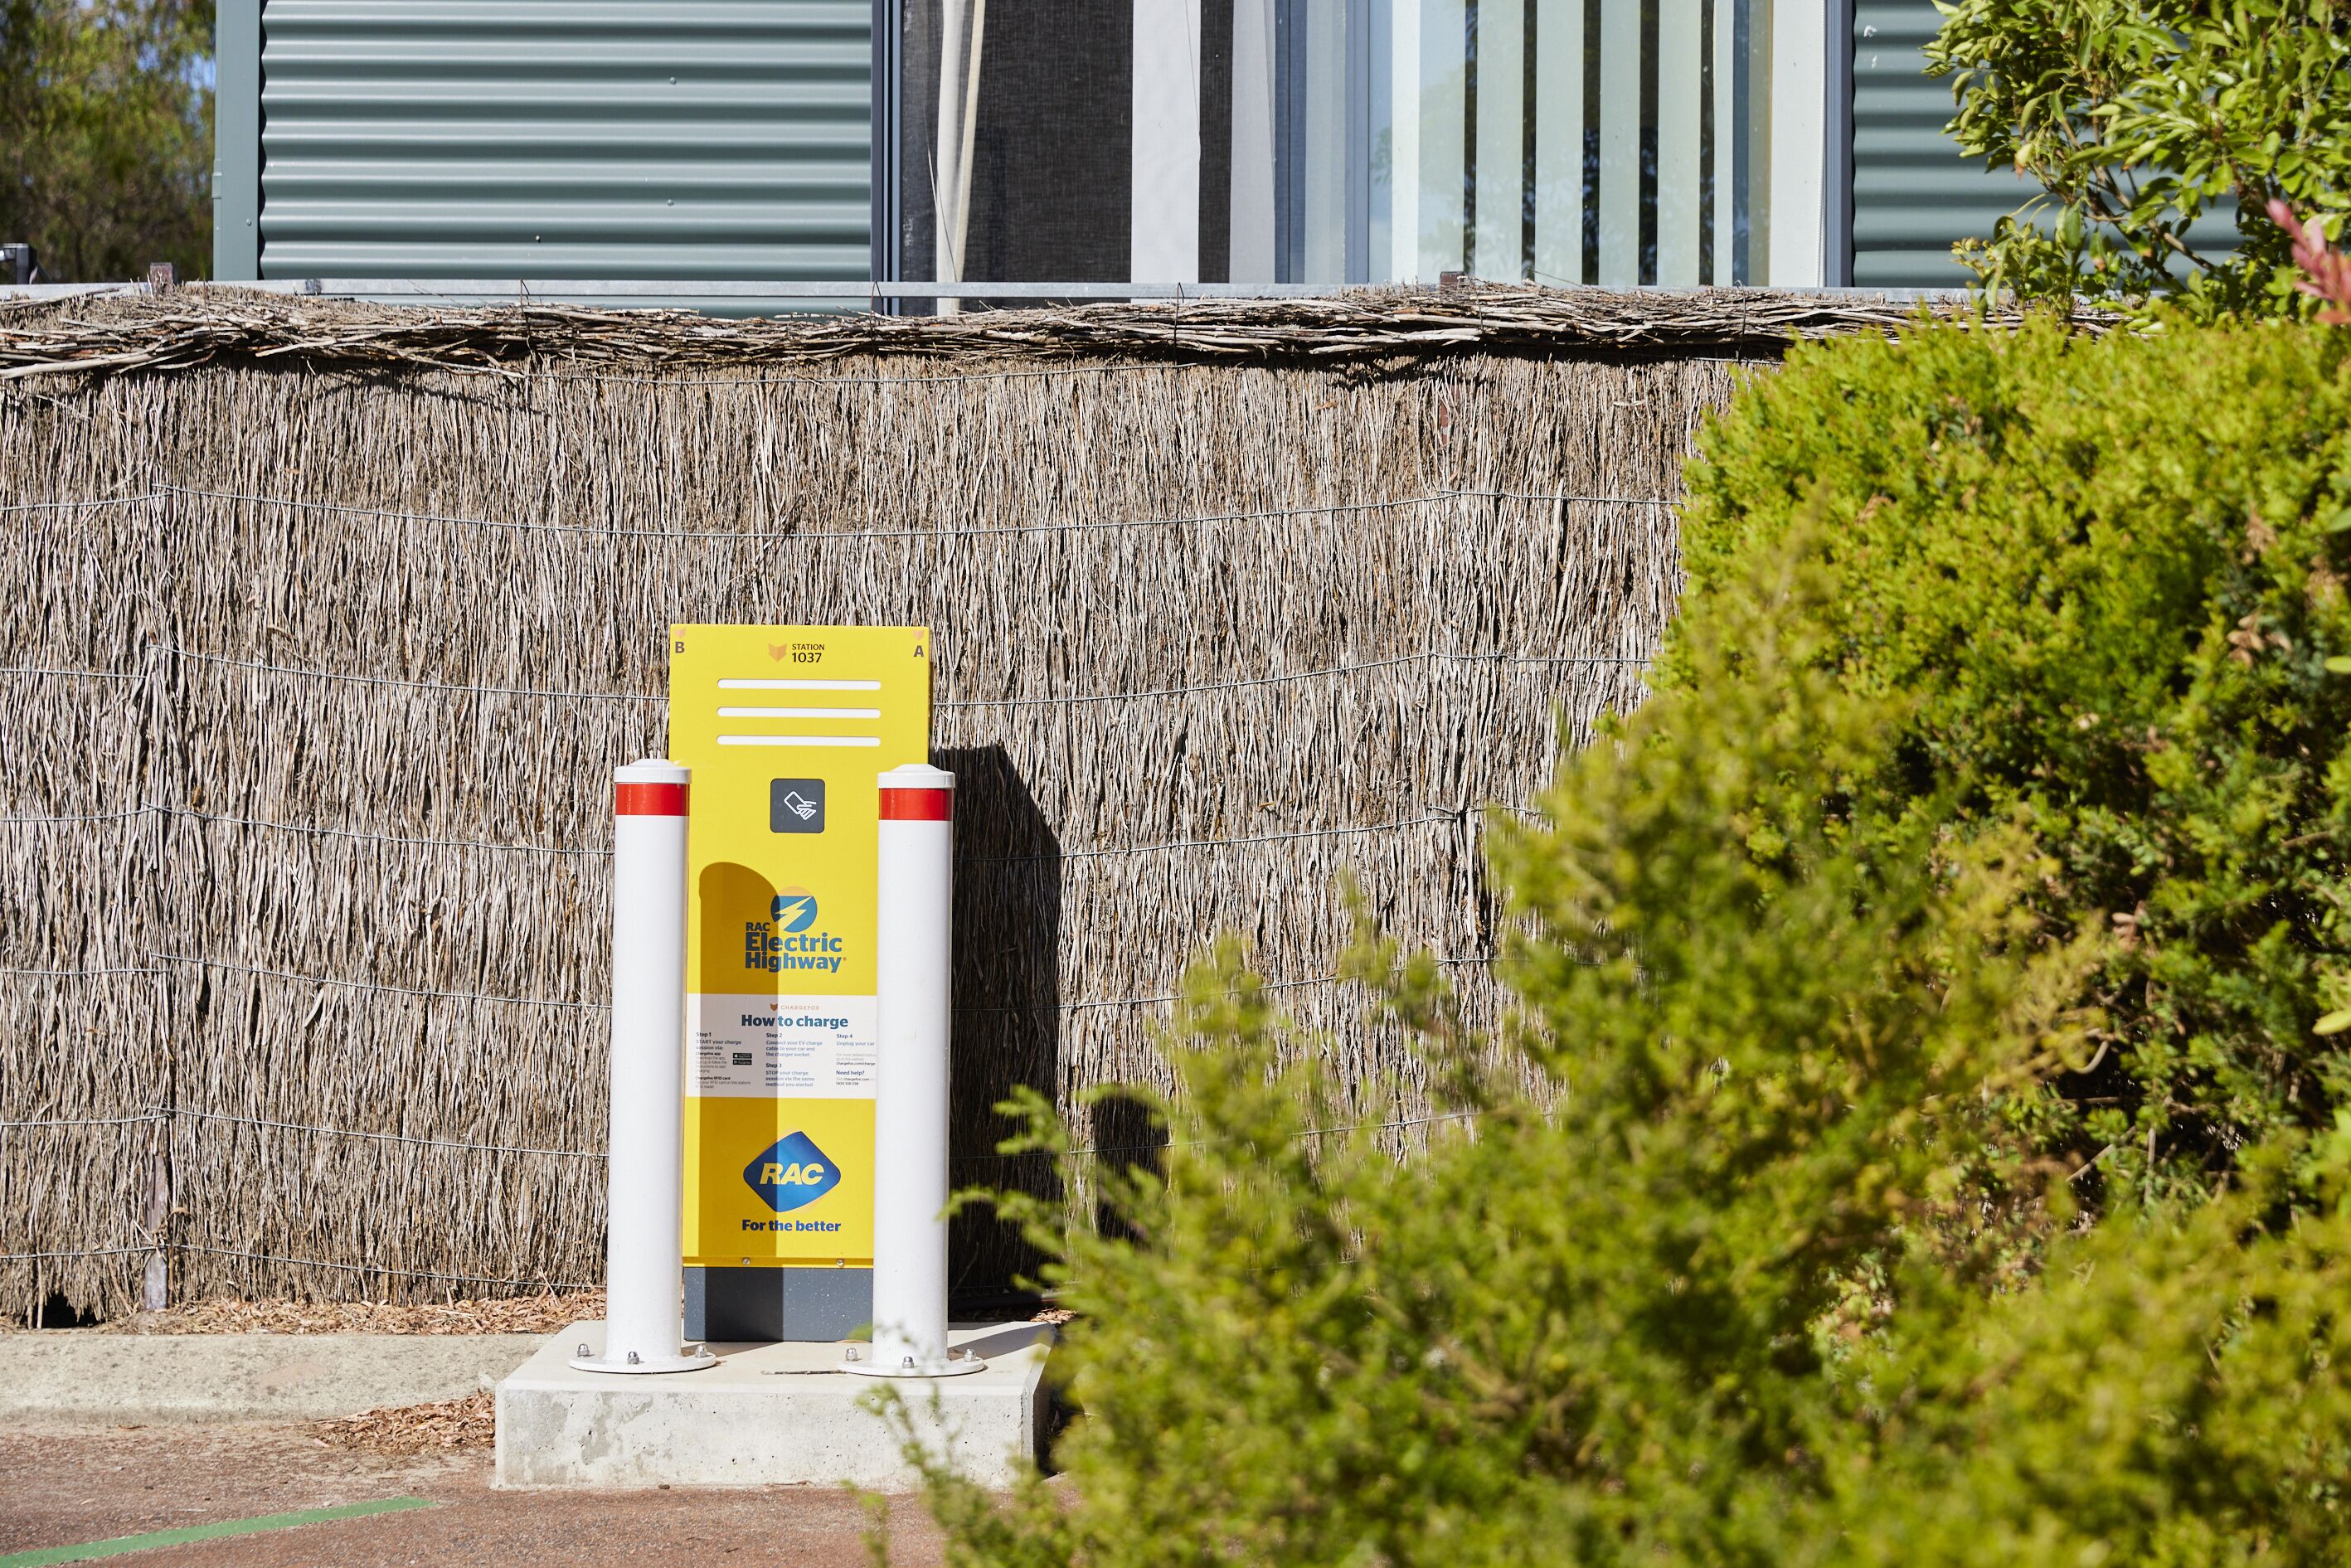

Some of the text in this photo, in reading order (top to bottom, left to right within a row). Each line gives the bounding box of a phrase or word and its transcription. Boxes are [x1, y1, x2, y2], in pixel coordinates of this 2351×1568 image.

[674, 641, 685, 653] B
[913, 645, 925, 658] A
[792, 653, 822, 663] 1037
[746, 922, 770, 931] RAC
[745, 932, 843, 952] Electric
[745, 952, 842, 973] Highway
[741, 1014, 848, 1030] How to charge
[760, 1163, 824, 1185] RAC
[742, 1219, 841, 1231] For the better
